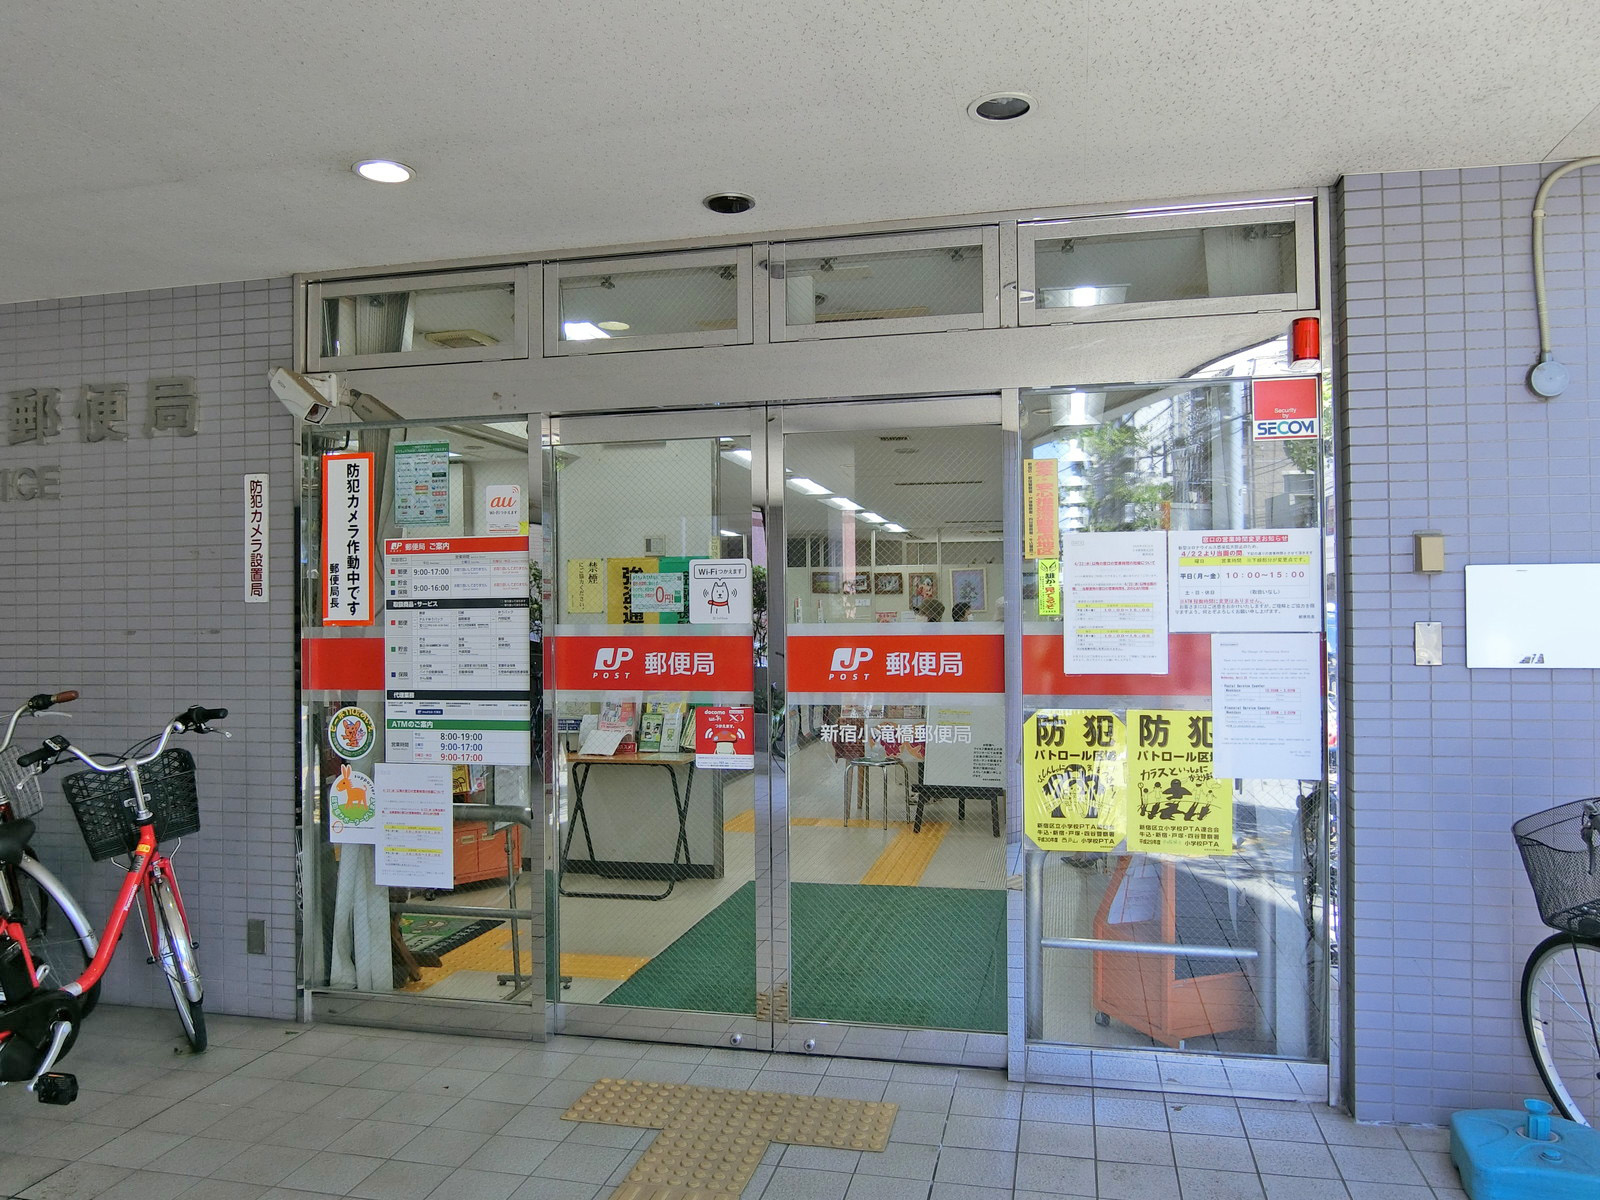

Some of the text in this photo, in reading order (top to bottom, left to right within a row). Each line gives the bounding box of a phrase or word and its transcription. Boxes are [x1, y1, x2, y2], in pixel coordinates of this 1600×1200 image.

[7, 376, 199, 446] 郵便局
[1258, 421, 1314, 435] SECOM
[490, 497, 516, 507] au
[250, 480, 262, 597] 防犯カメラ設置局
[347, 464, 360, 615] 防犯カメラ作動中です
[588, 563, 598, 584] 禁煙
[330, 563, 339, 608] 郵便局長
[594, 648, 633, 670] JP
[645, 652, 714, 675] 郵便局
[831, 648, 873, 671] JP
[886, 652, 963, 676] 郵便局
[820, 724, 972, 744] 新宿小滝橋郵便局
[1036, 715, 1114, 747] 防犯
[1139, 715, 1212, 748] 防犯
[1138, 752, 1213, 762] パトロール区
[1141, 766, 1208, 781] カラスといっしょに
